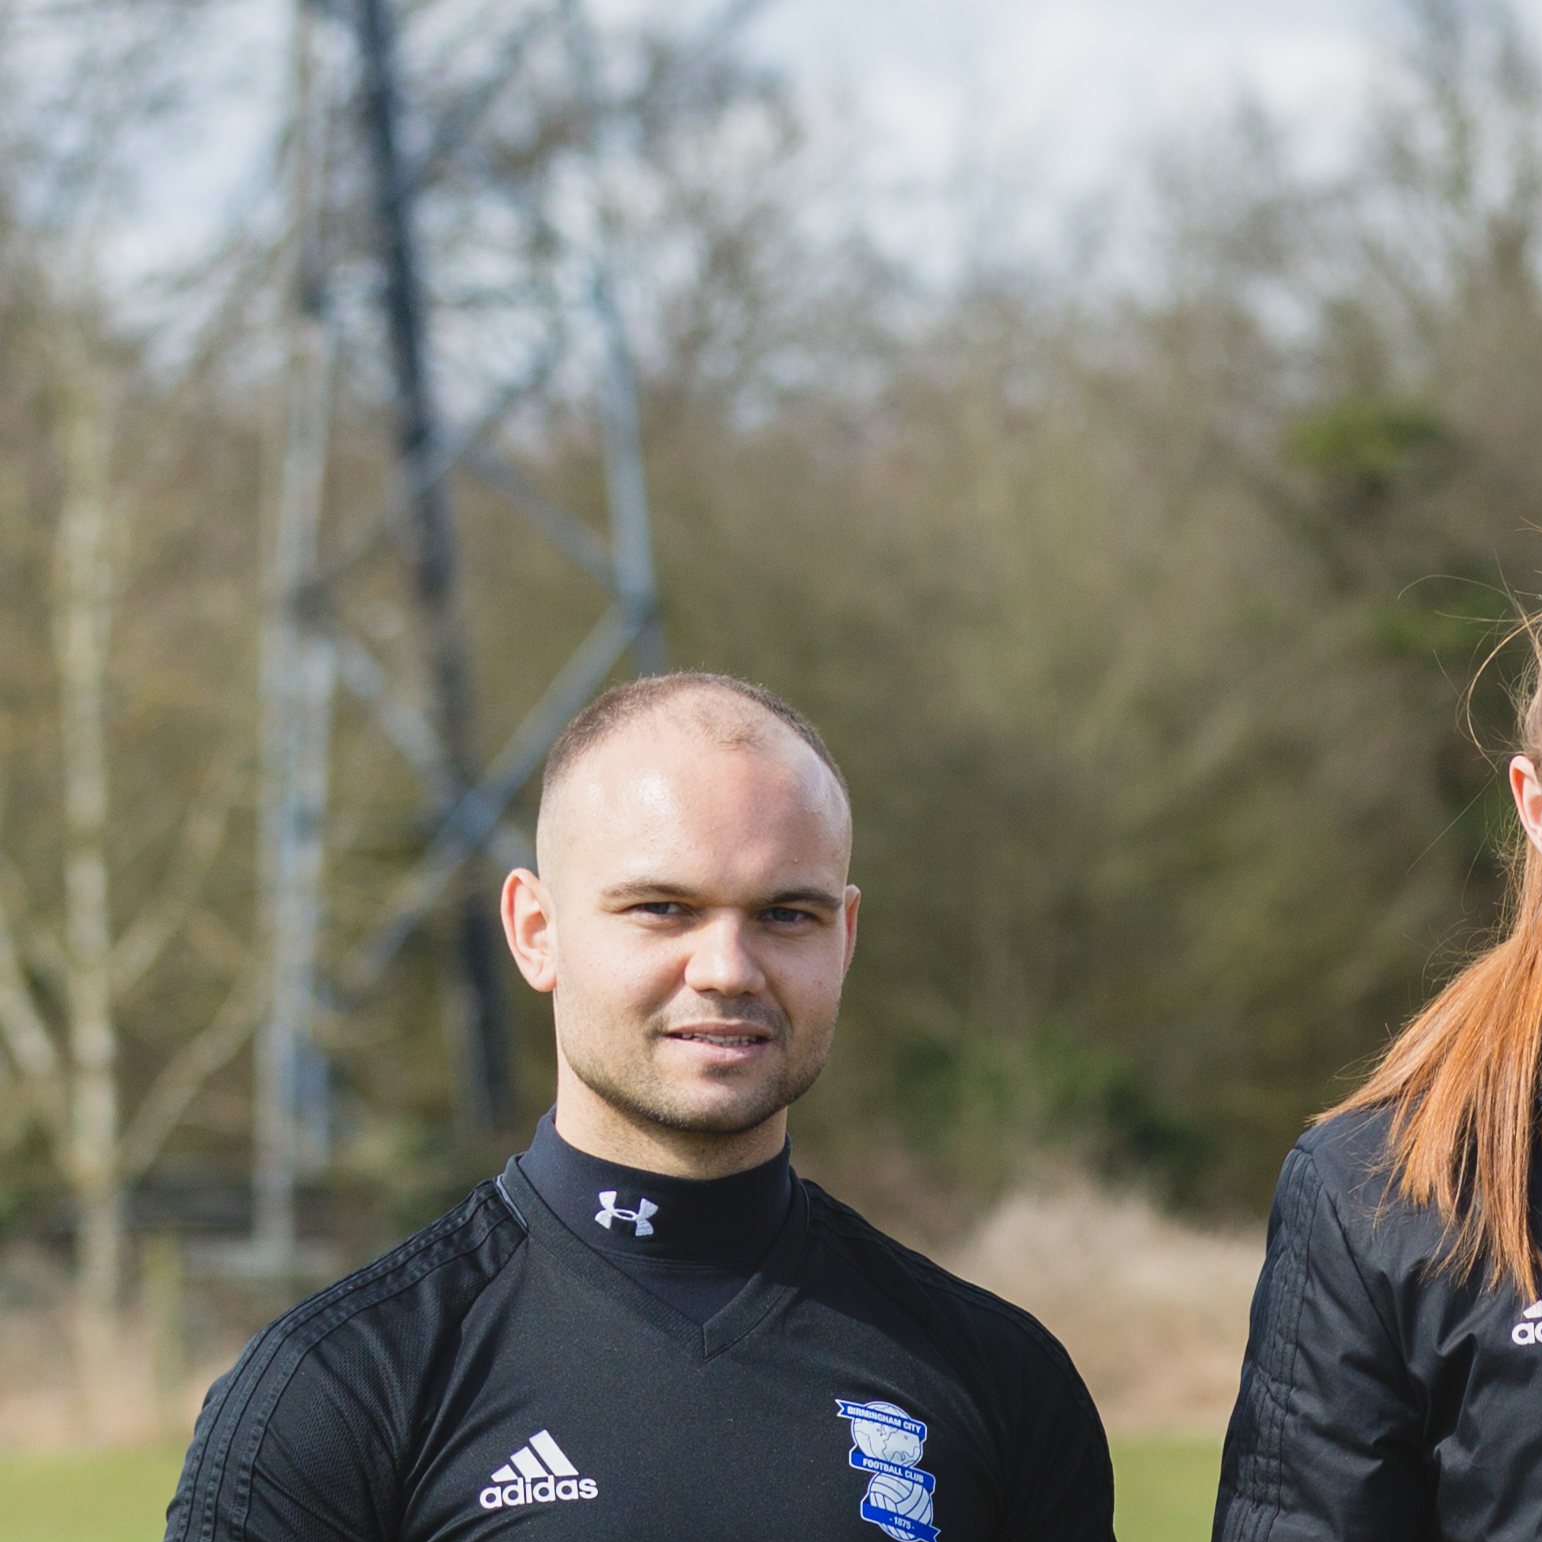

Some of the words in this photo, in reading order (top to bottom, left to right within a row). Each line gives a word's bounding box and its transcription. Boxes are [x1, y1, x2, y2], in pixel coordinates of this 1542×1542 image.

[847, 1405, 902, 1427] BIRMINGHAM
[903, 1421, 922, 1434] CITY
[863, 1458, 904, 1477] FOOTBALL
[904, 1469, 924, 1484] CLUB
[479, 1474, 599, 1510] adidas
